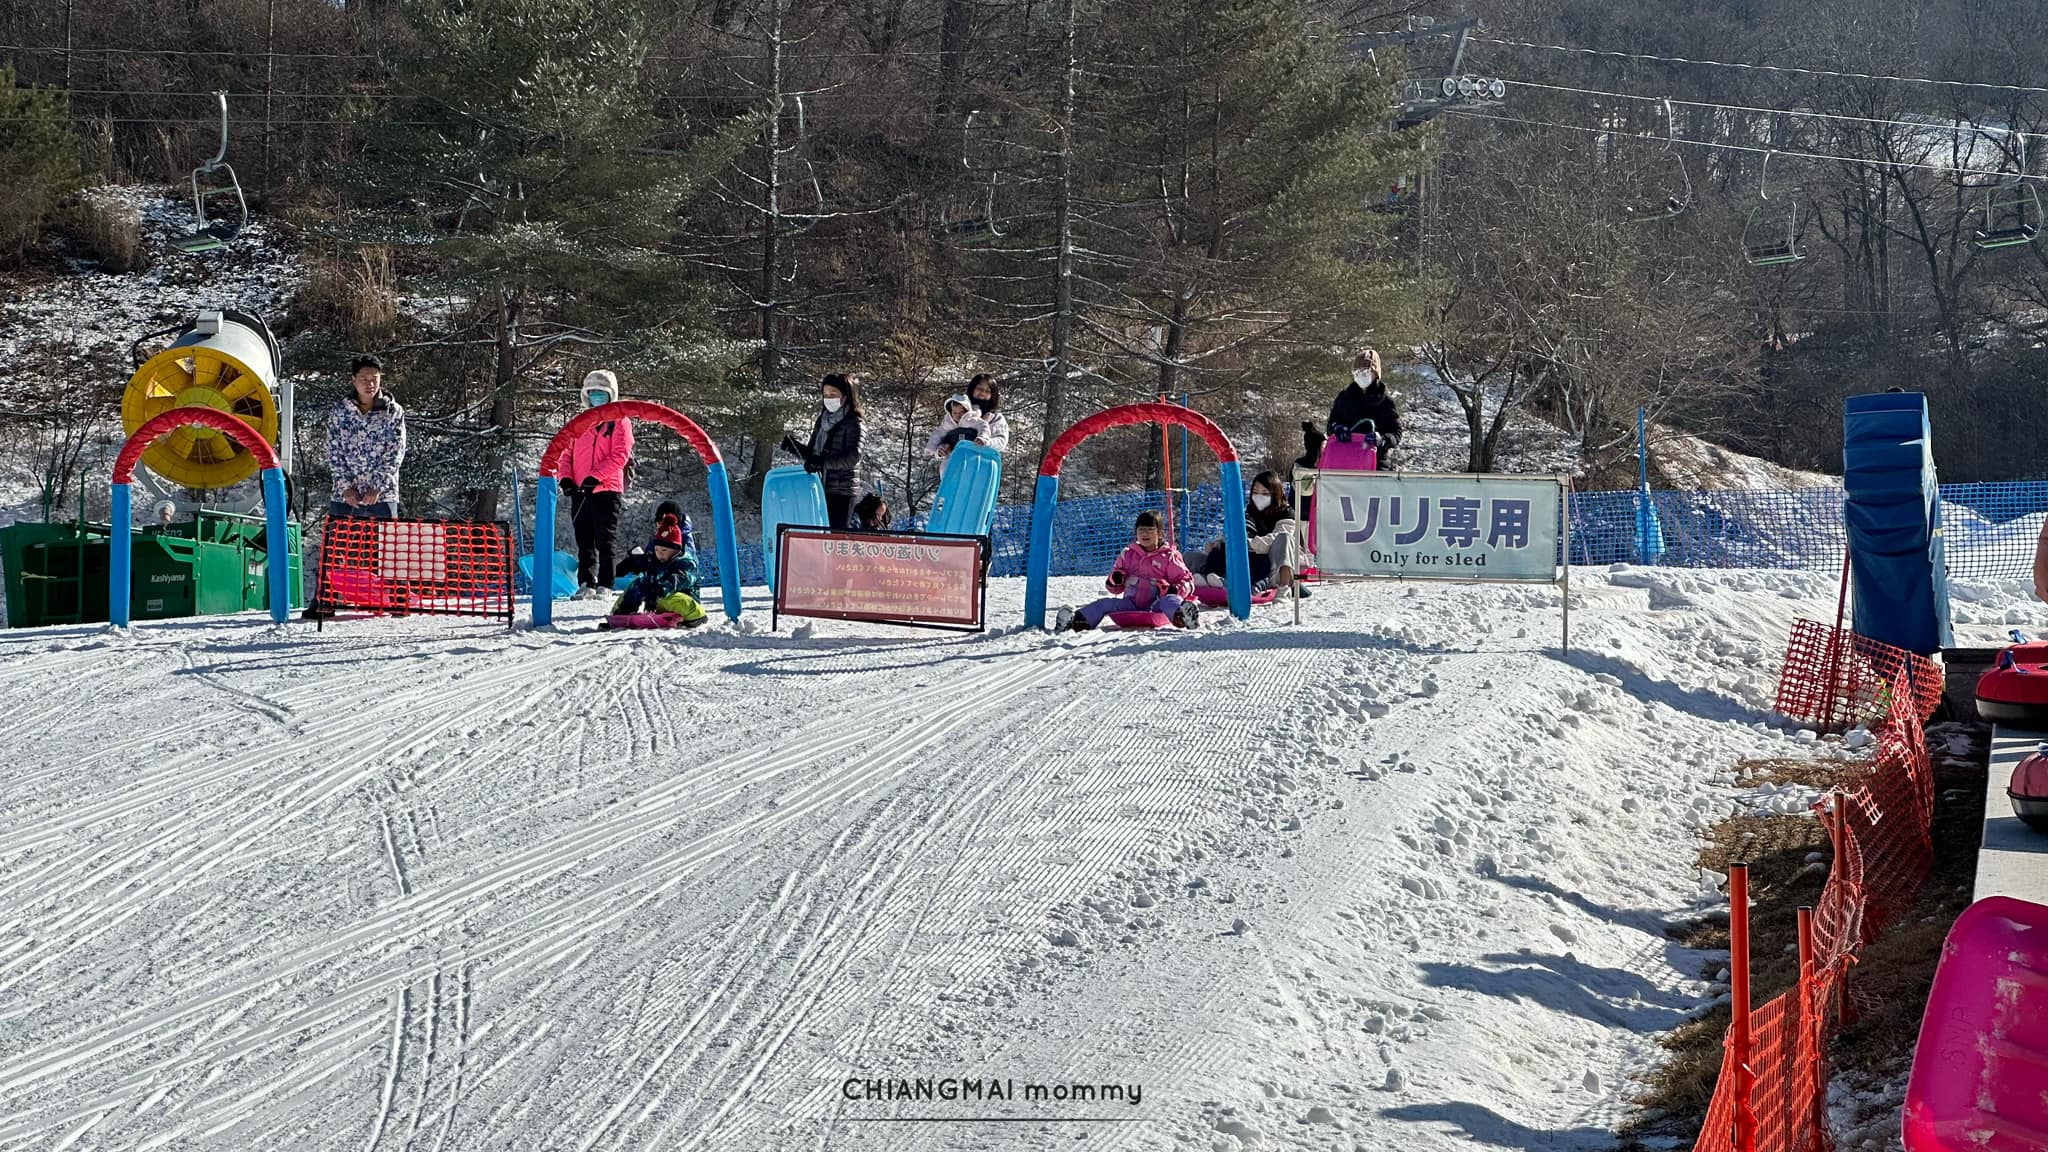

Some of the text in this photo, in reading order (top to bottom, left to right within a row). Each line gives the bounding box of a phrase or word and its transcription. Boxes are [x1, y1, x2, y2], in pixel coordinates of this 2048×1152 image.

[1339, 496, 1531, 550] ソリ専用
[1370, 550, 1487, 566] Only for sled
[151, 573, 186, 584] Kashiyama
